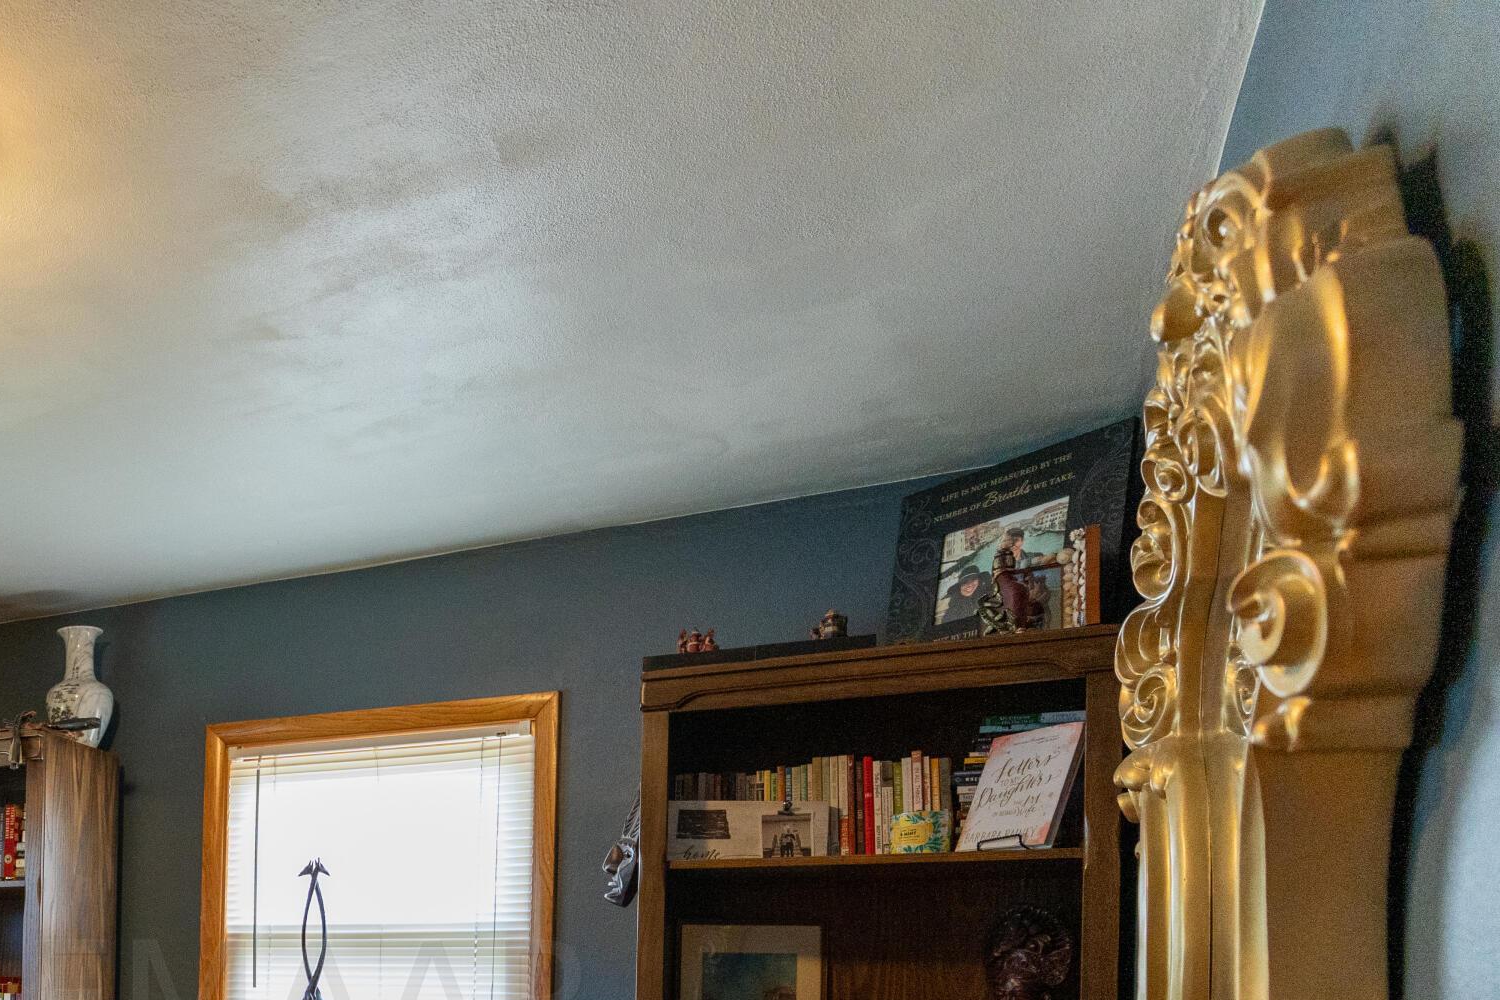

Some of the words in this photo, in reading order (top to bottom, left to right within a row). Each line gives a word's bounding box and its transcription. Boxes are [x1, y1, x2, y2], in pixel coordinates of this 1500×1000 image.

[941, 490, 959, 504] LIFE
[960, 488, 970, 497] IS
[970, 482, 988, 494] NOT
[990, 465, 1039, 486] MEASURED
[1040, 460, 1051, 470] BY
[1052, 452, 1074, 465] THE
[933, 507, 968, 523] NUMBER
[969, 502, 982, 513] OF
[1033, 481, 1049, 491] WE
